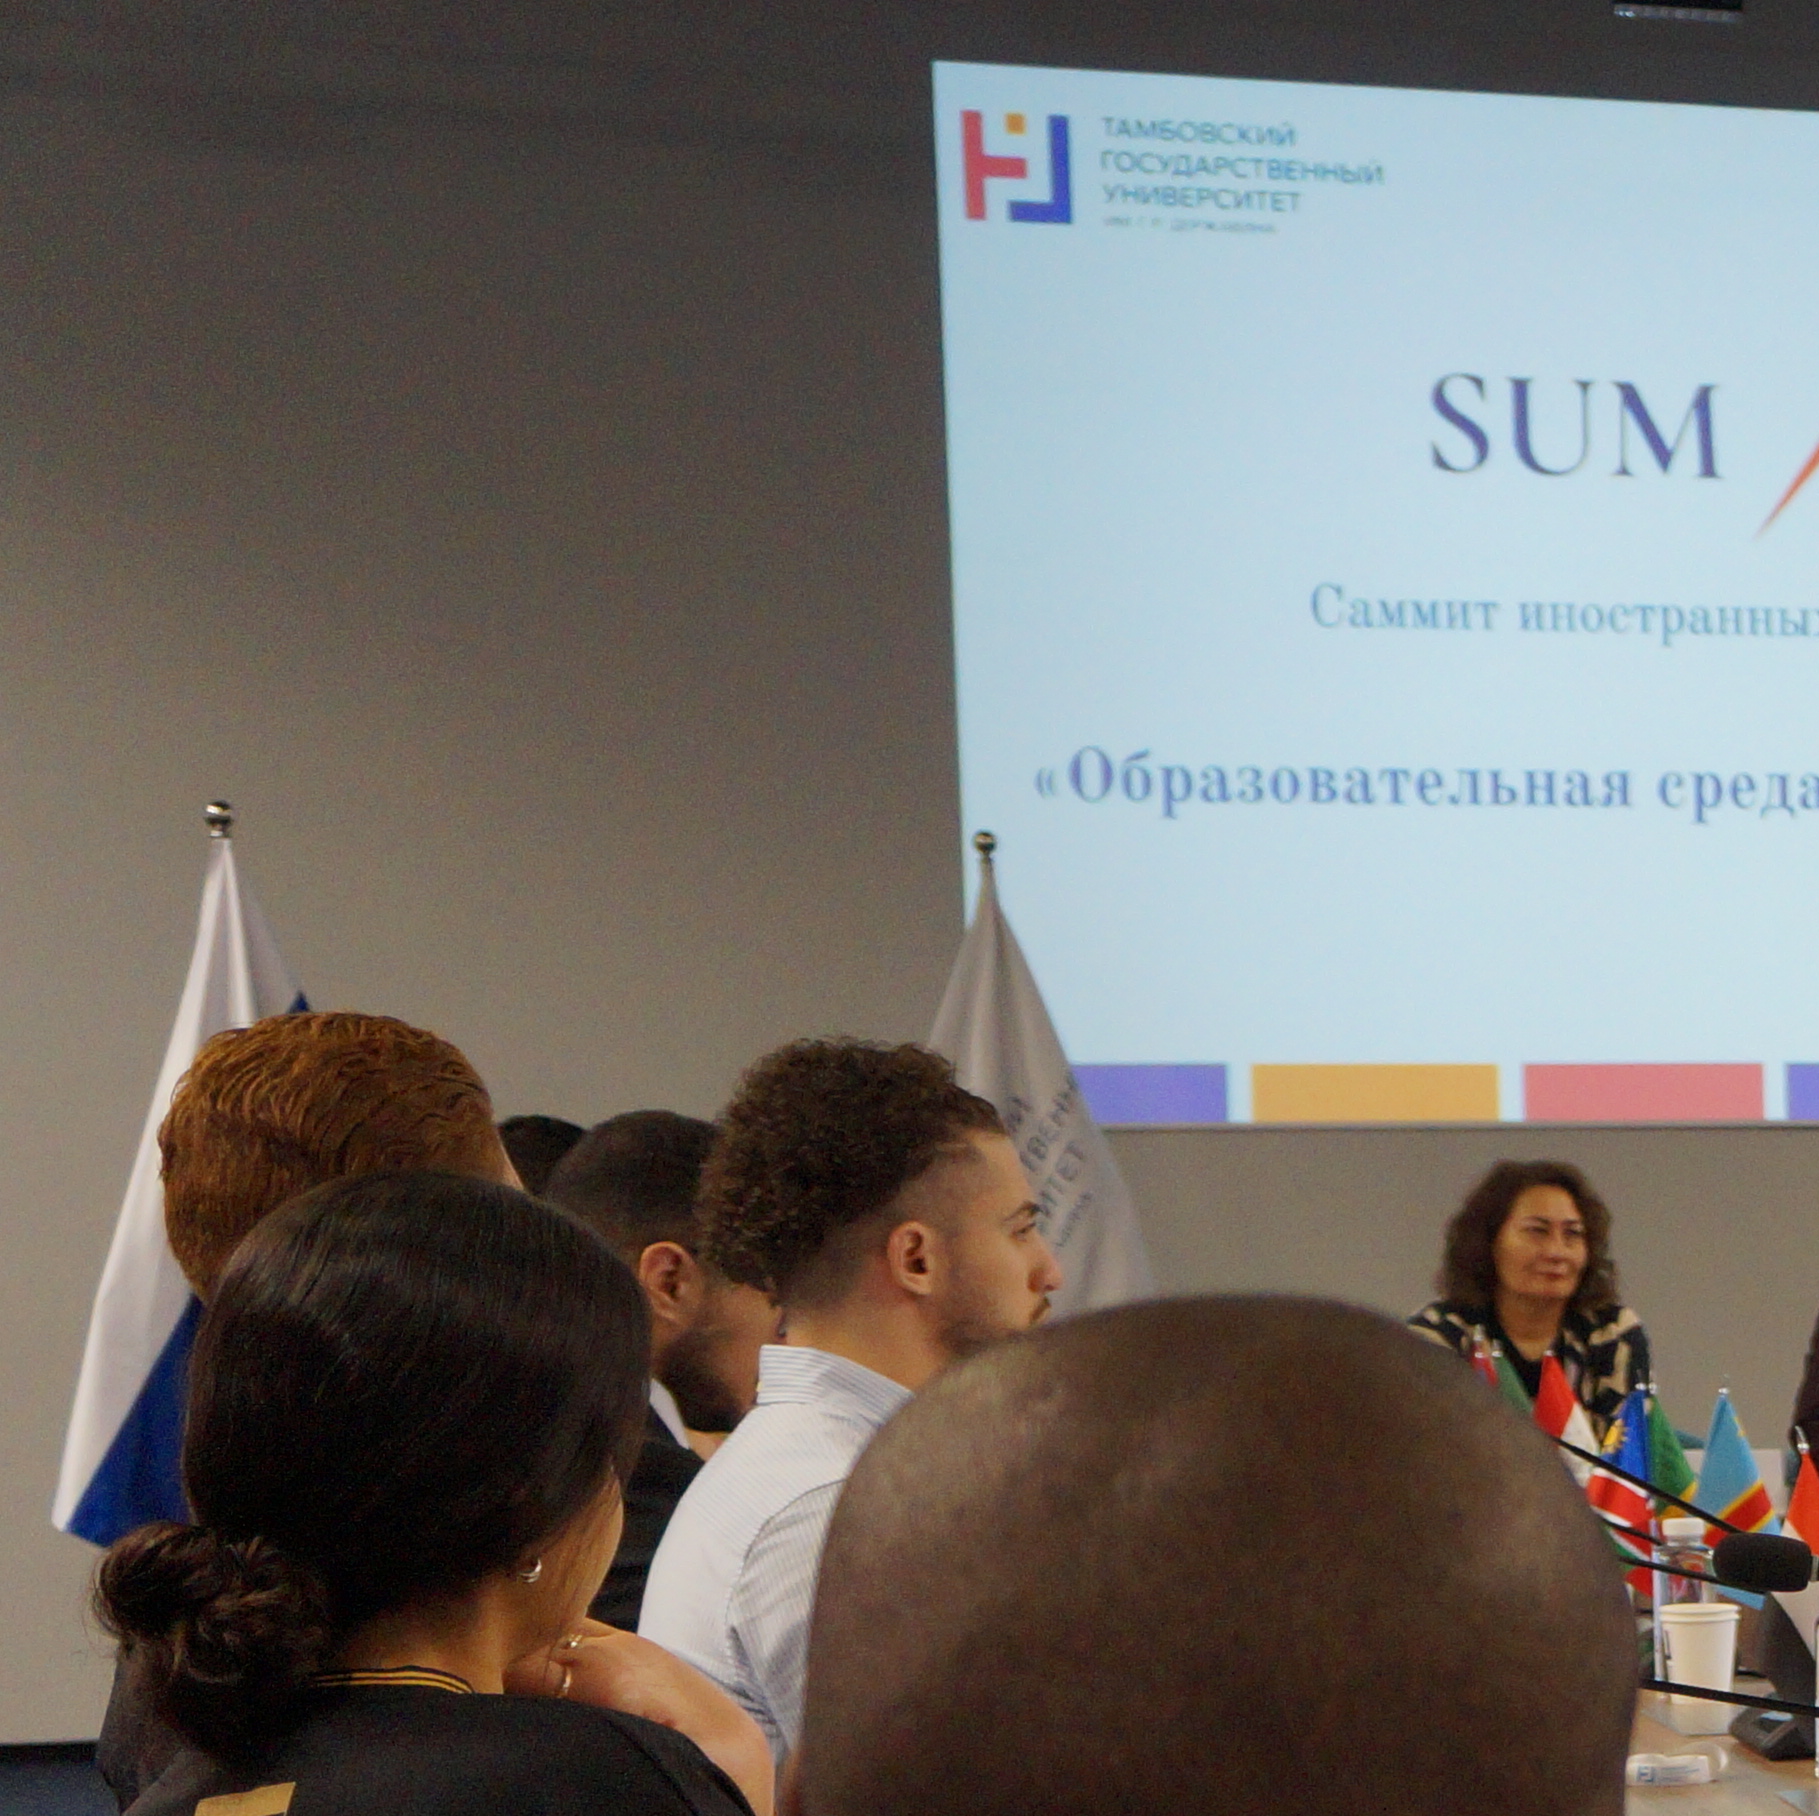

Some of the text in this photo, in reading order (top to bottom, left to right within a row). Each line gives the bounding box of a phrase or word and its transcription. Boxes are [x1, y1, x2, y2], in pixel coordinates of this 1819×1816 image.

[1101, 115, 1294, 145] ТАМБОВСКИЙ
[1101, 149, 1382, 184] ГОСУДАРСТВЕННЫЙ
[1101, 182, 1303, 212] УНИВЕРСИТЕТ
[1310, 582, 1500, 631] Саммит
[1034, 744, 1632, 820] «Образовательная
